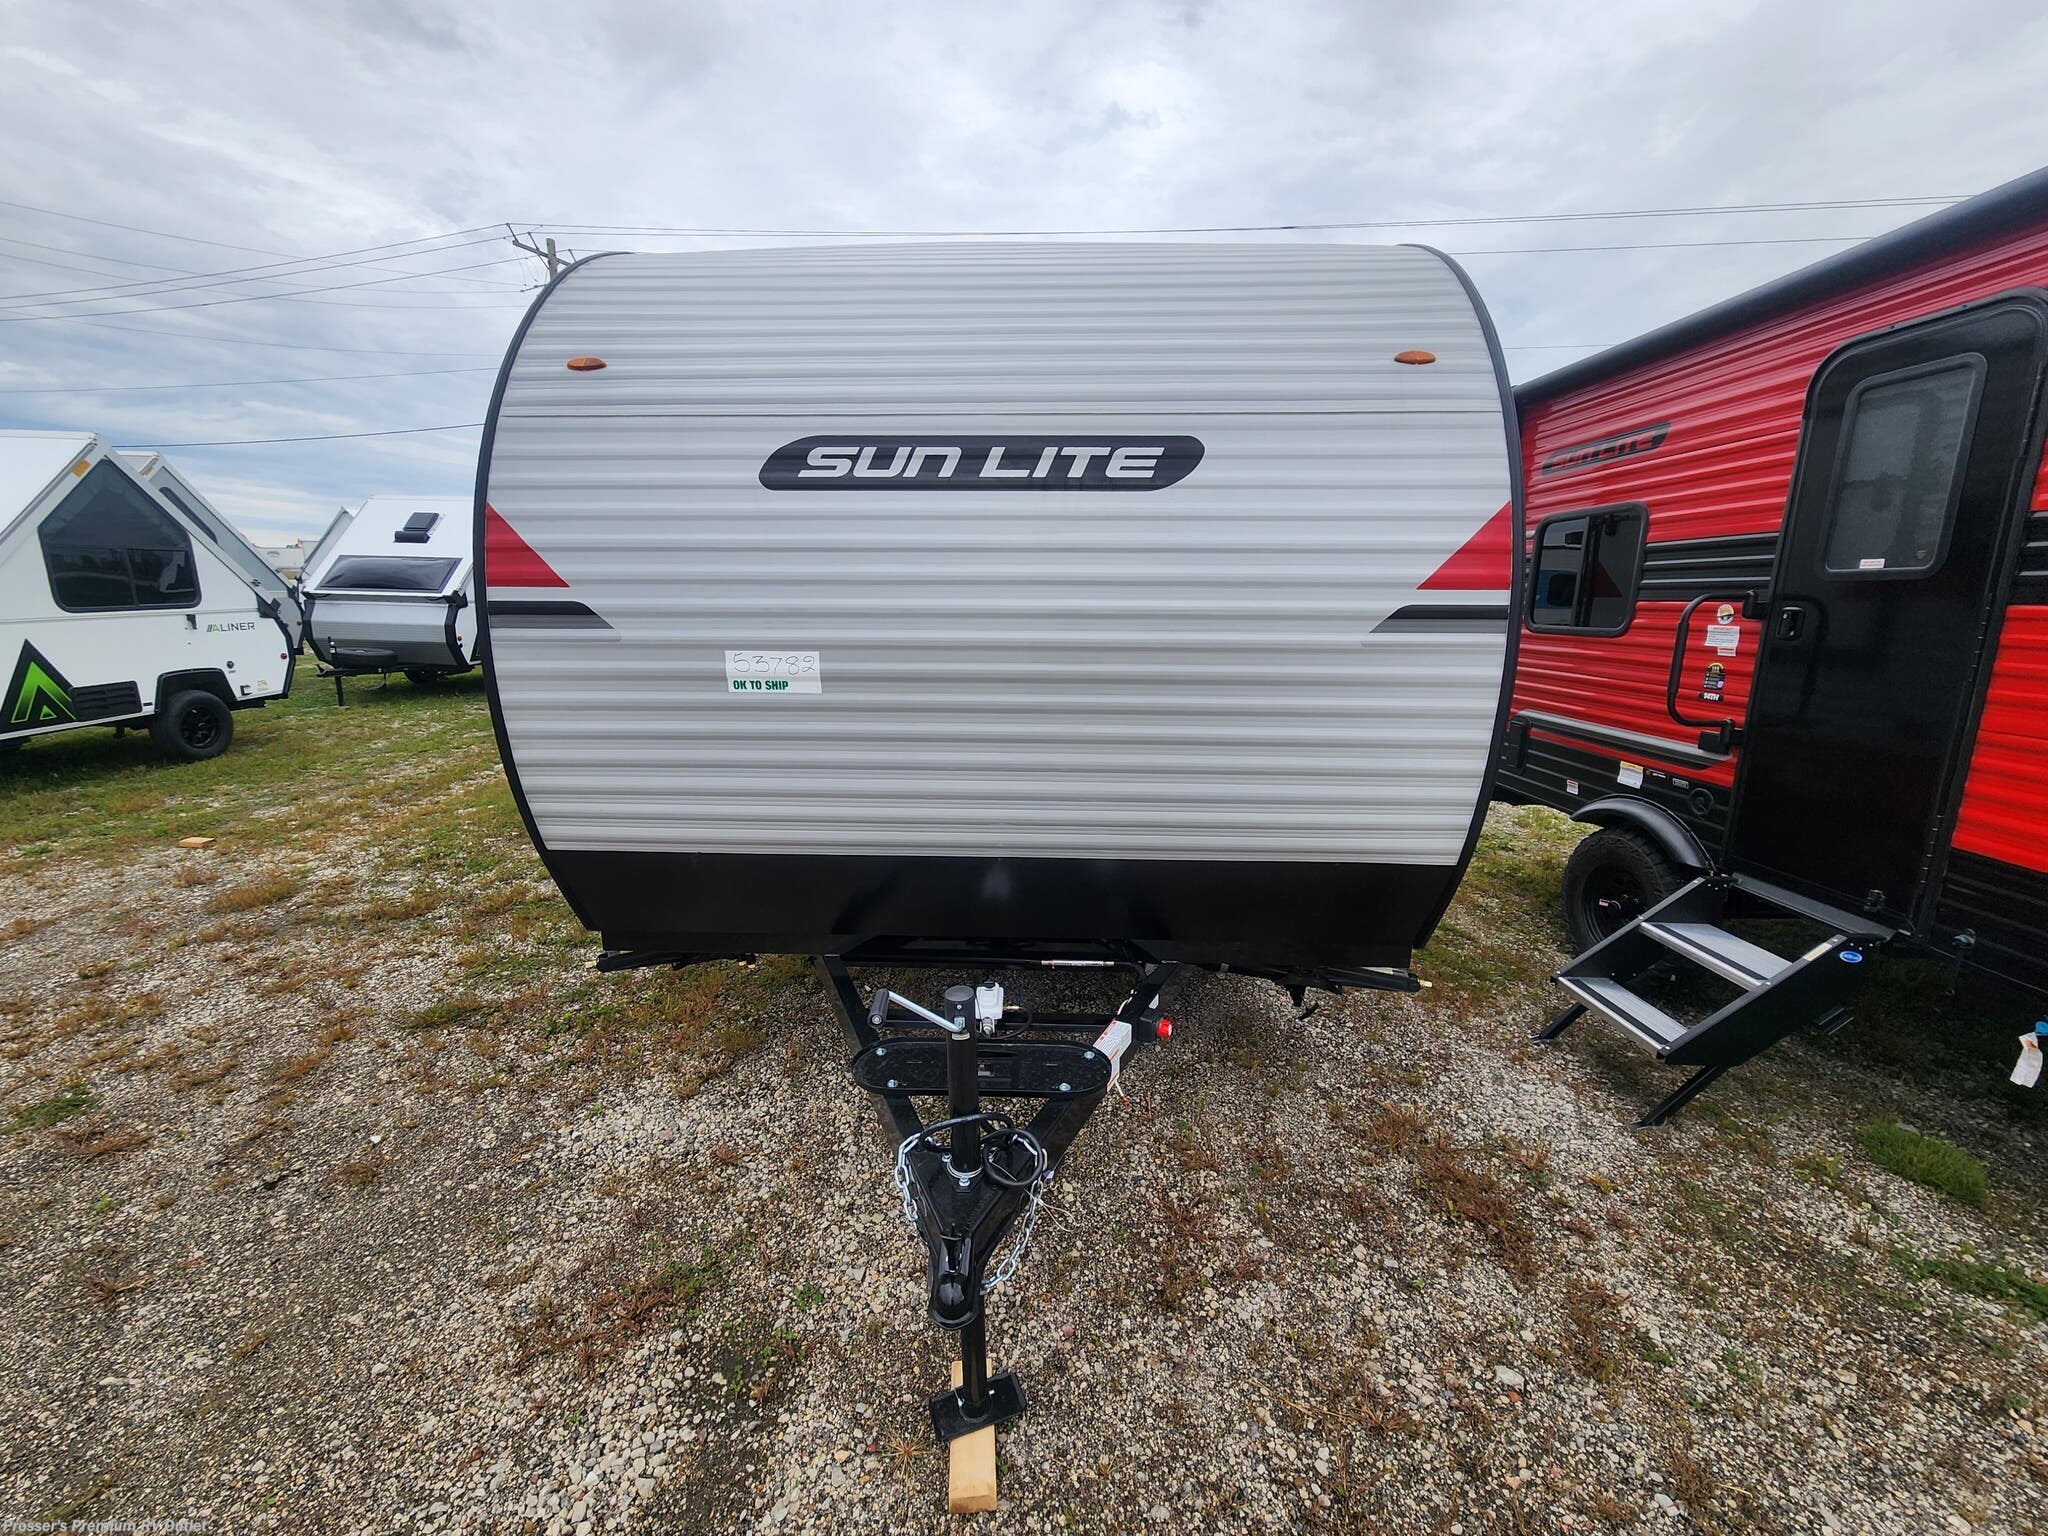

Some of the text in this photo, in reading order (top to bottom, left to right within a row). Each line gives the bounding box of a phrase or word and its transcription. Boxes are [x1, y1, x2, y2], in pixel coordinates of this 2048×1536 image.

[797, 447, 1165, 478] SUN LITE
[207, 622, 255, 632] ALINER
[734, 653, 816, 675] 53782
[733, 680, 789, 690] OK TO SHIP
